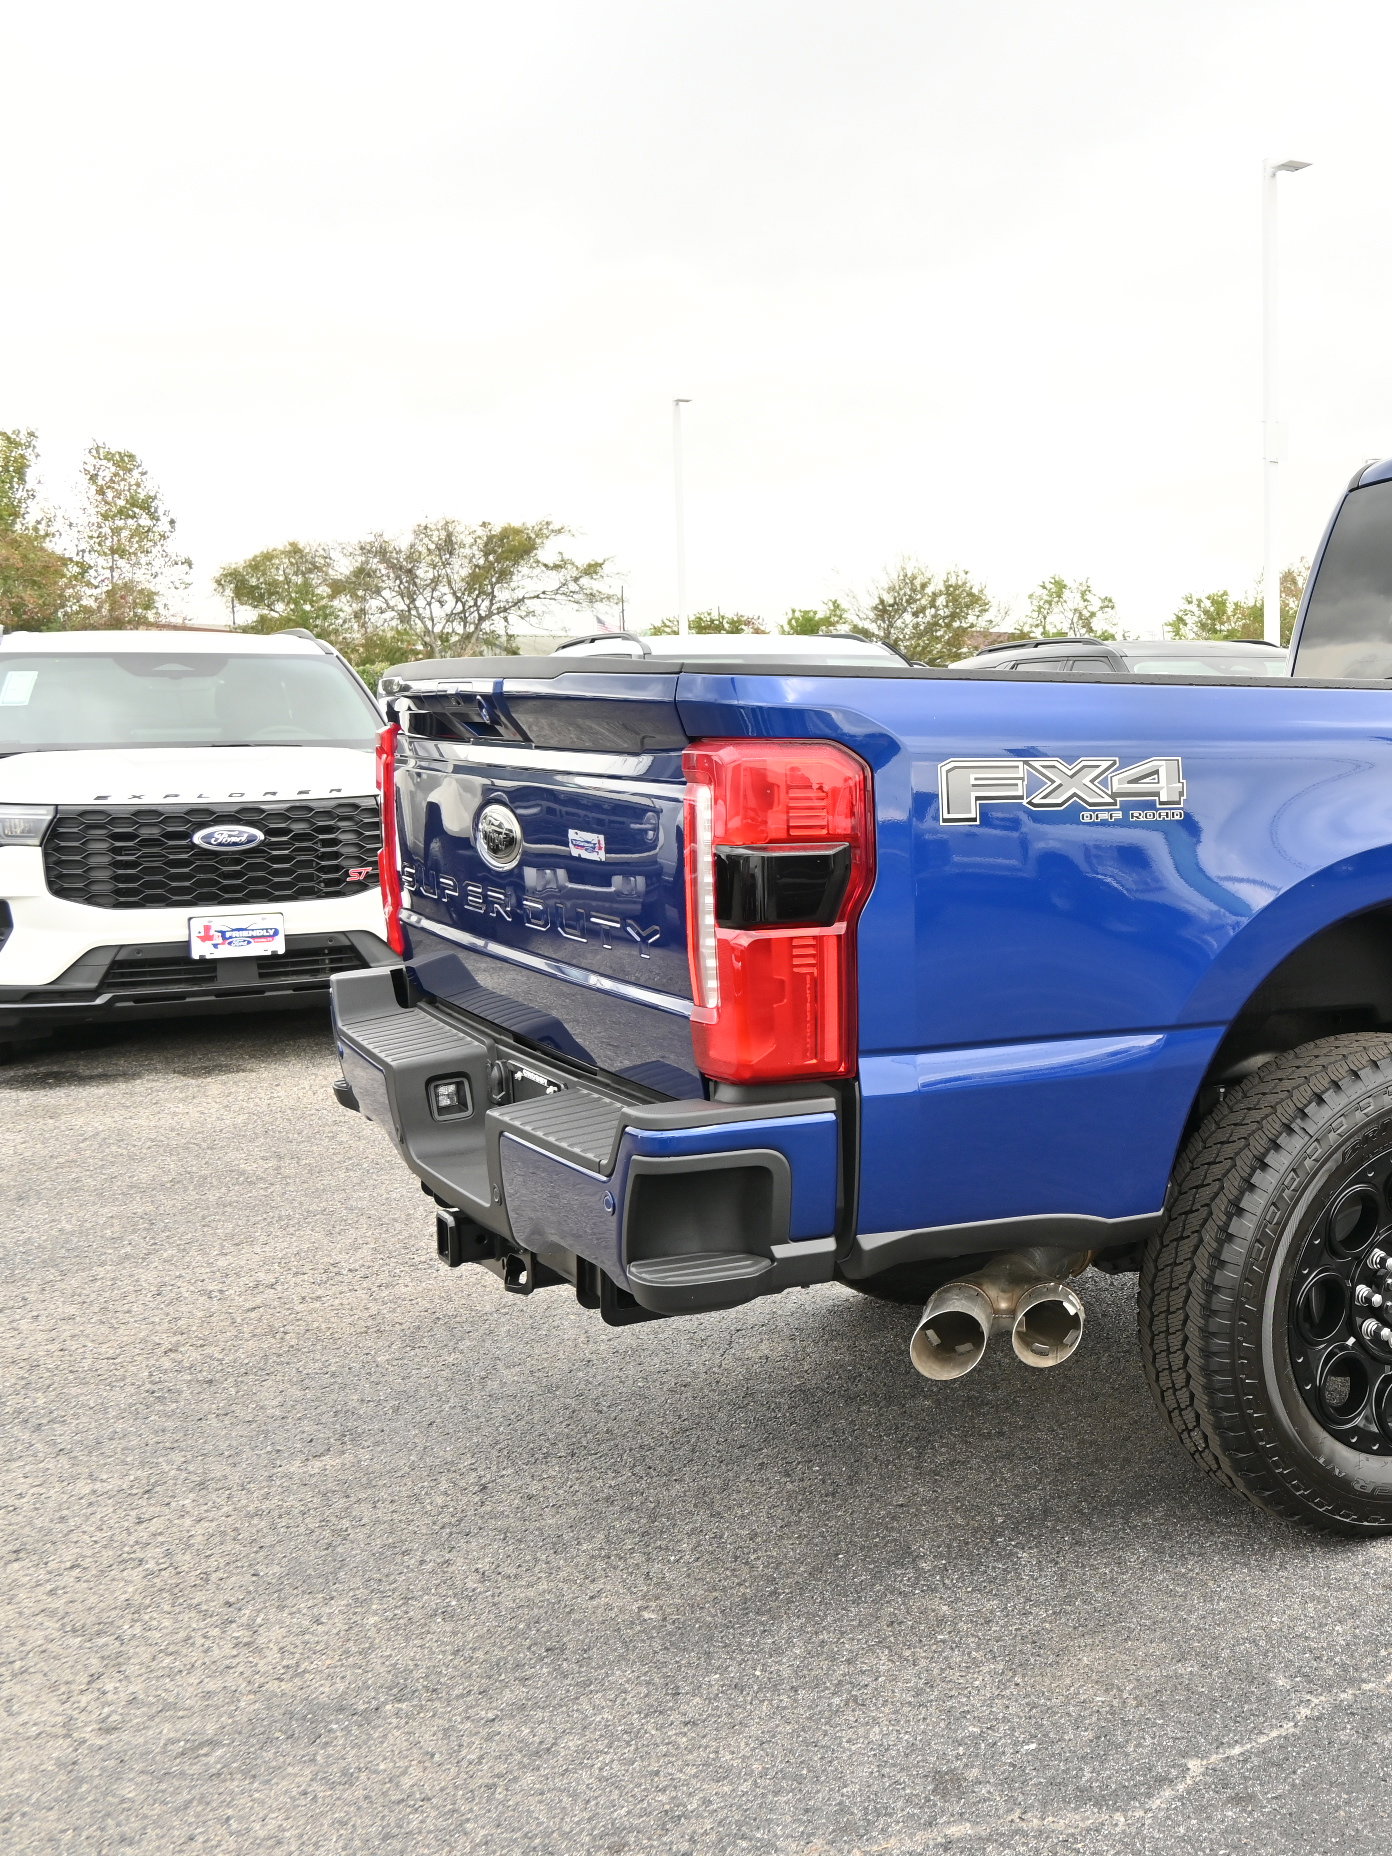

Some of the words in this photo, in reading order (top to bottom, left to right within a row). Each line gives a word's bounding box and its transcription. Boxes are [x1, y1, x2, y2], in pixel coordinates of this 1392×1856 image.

[93, 788, 343, 801] EXPLORER
[937, 757, 1187, 825] FX4
[1080, 811, 1122, 822] OFF
[1129, 810, 1184, 821] ROAD
[211, 830, 248, 845] Ford
[346, 867, 373, 882] ST
[401, 861, 513, 922] SUPER
[522, 896, 661, 959] DUTY
[225, 928, 275, 938] FRIENDLY
